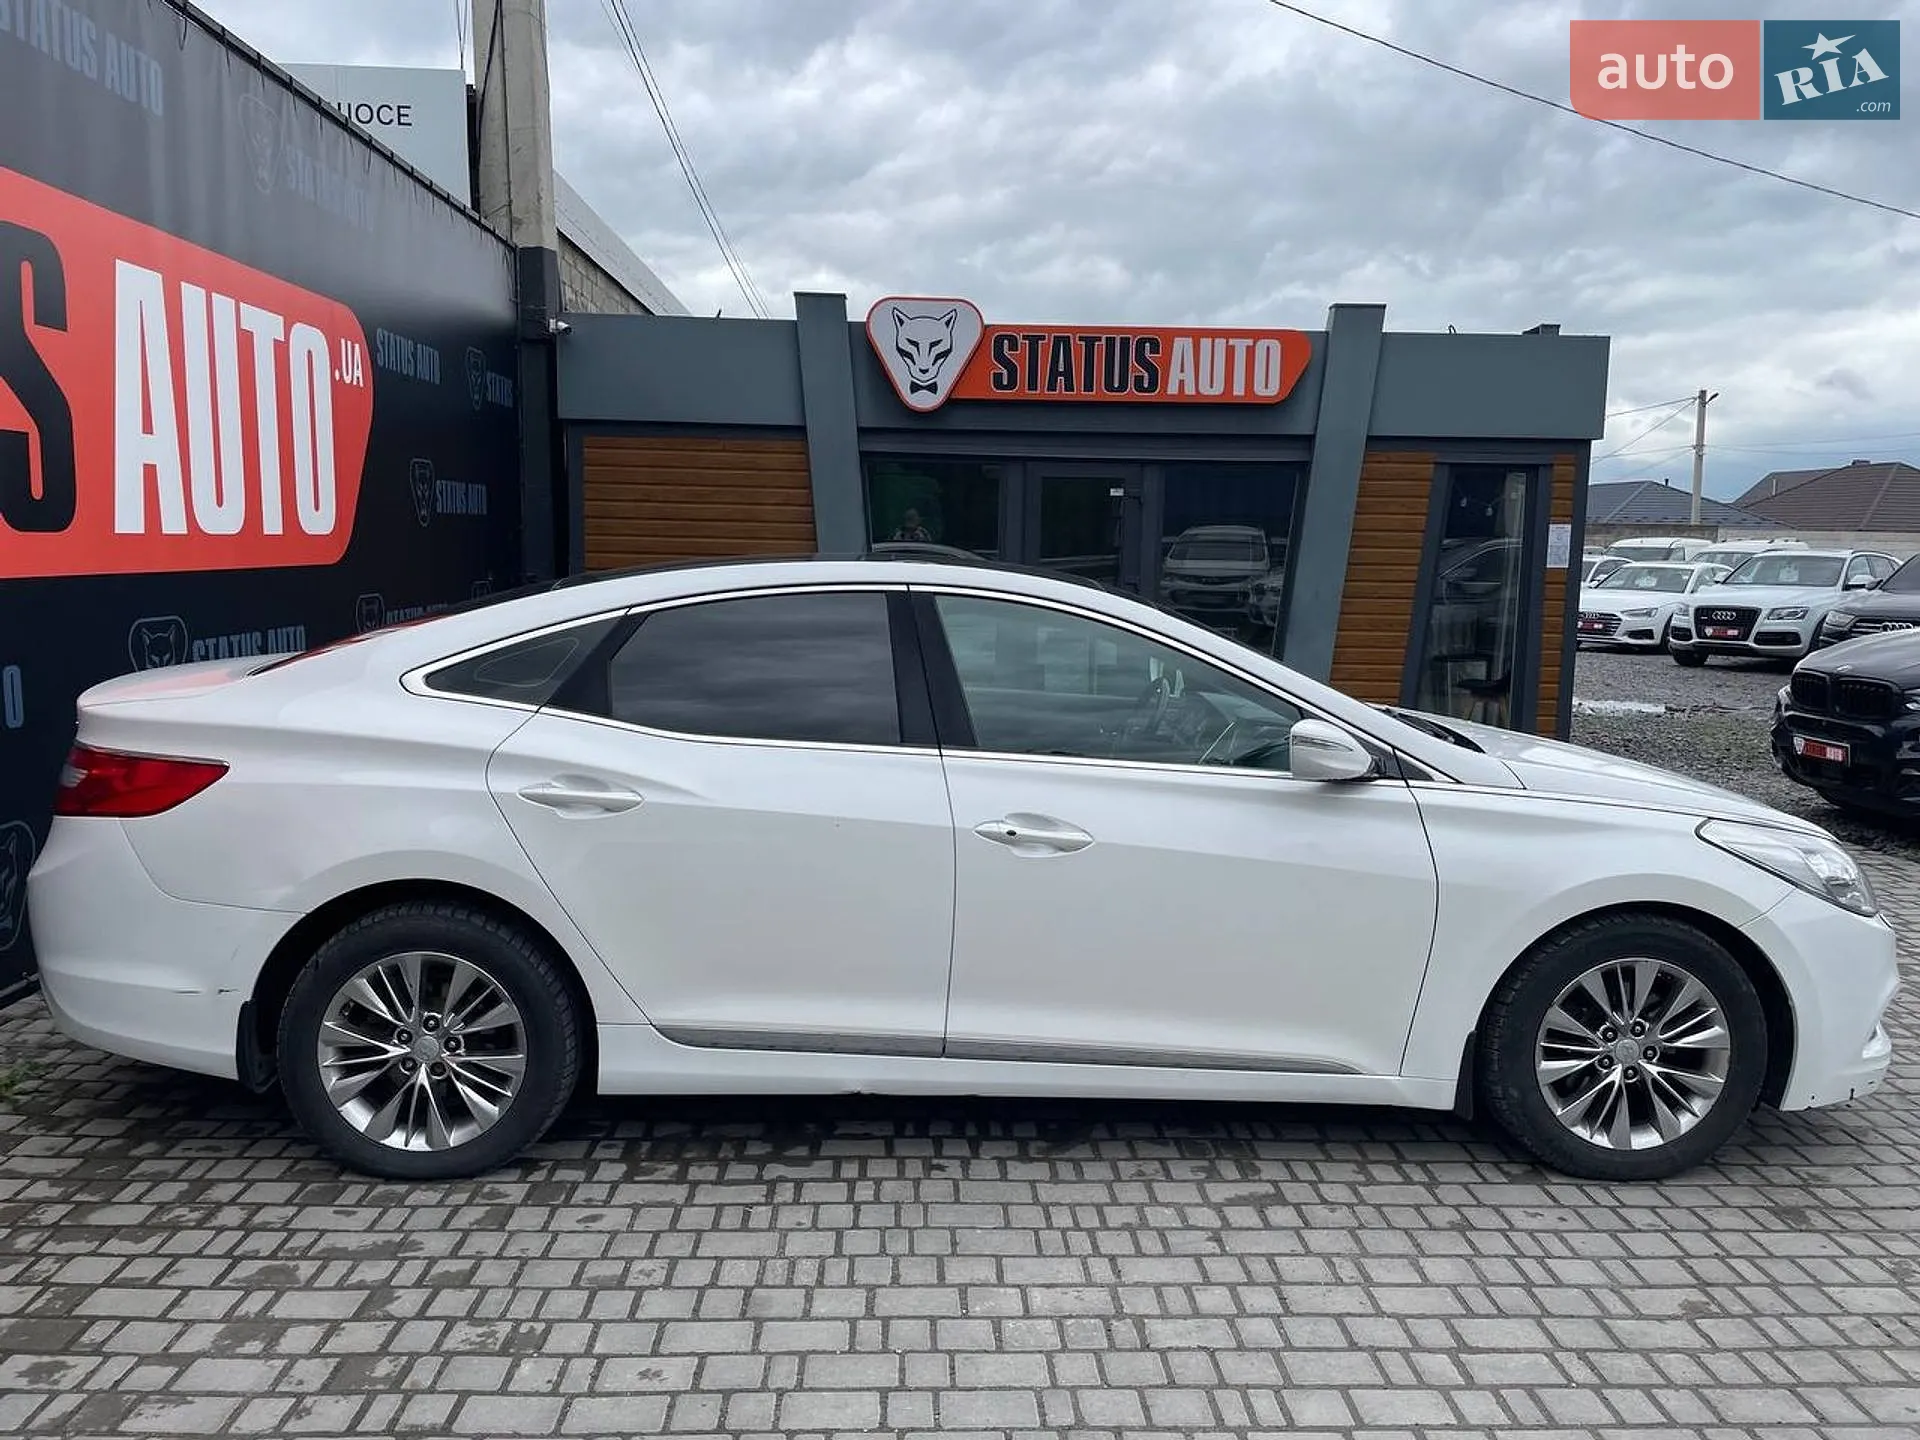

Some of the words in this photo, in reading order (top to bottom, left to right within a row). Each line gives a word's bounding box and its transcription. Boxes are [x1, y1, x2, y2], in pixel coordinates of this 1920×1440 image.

[104, 30, 163, 117] AUTO
[376, 327, 415, 377] STATUS
[416, 343, 441, 385] AUTO
[990, 332, 1161, 396] STATUS
[1166, 336, 1281, 397] AUTO
[114, 258, 337, 535] AUTO
[436, 479, 467, 514] STATUS
[468, 483, 488, 515] AUTO
